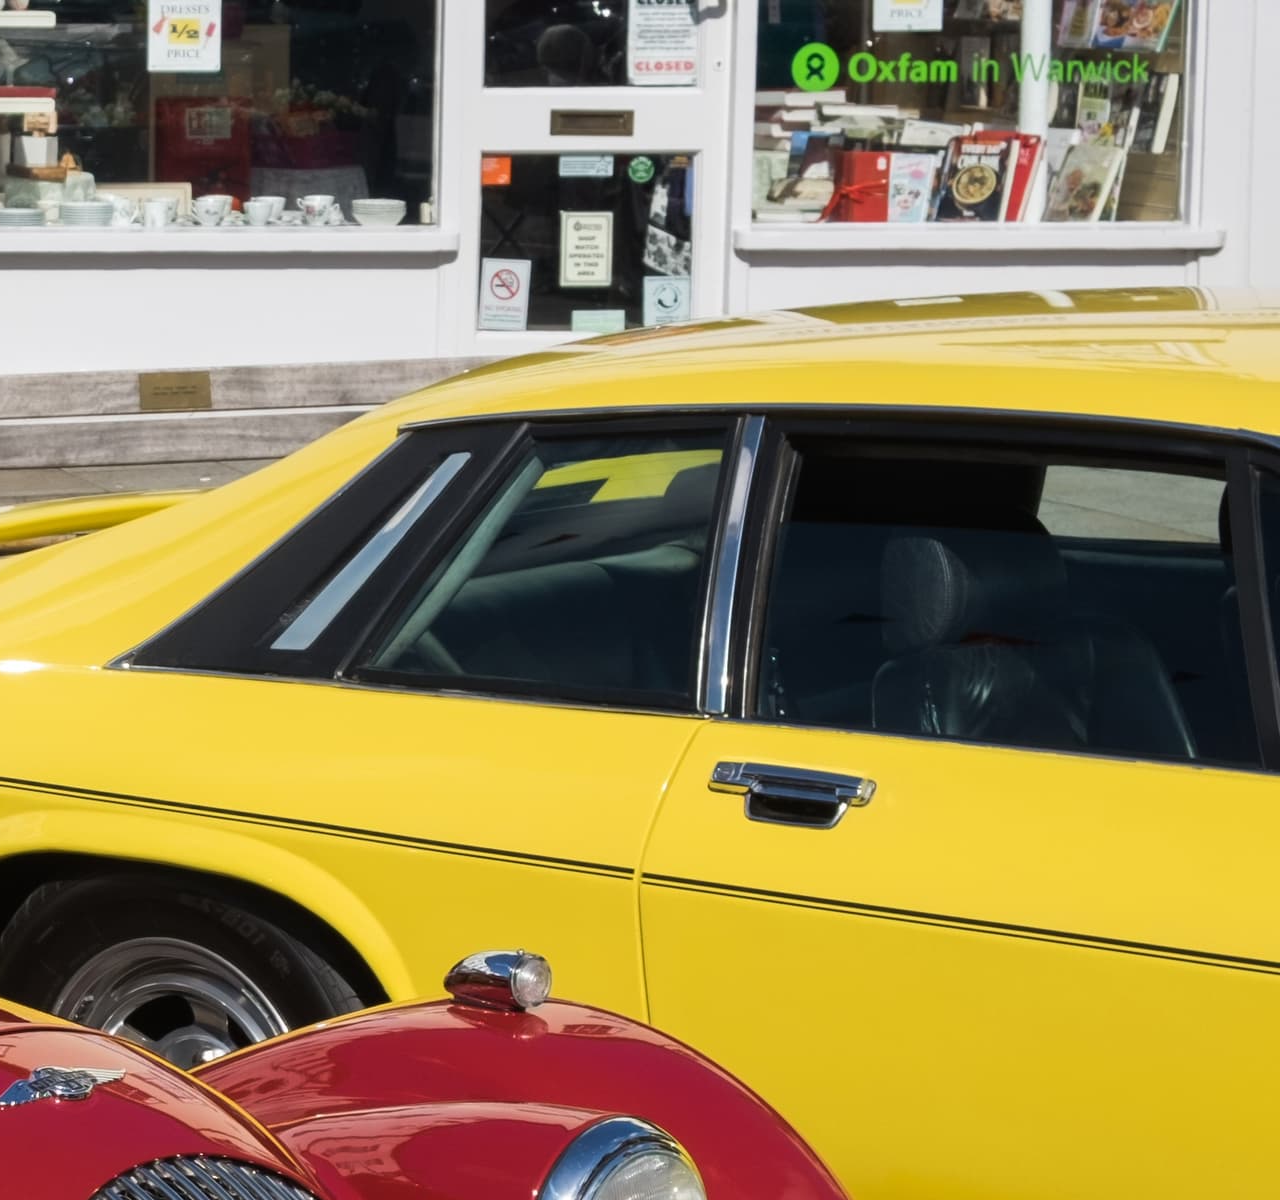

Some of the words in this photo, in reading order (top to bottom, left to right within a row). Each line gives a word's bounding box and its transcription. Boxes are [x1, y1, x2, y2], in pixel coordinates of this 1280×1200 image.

[890, 8, 924, 18] PRICE
[170, 23, 200, 38] 1/2
[167, 49, 200, 58] PRICE
[635, 61, 694, 71] CLOSED
[848, 53, 958, 83] Oxfam
[972, 53, 1000, 82] in
[1011, 53, 1150, 83] Warwick
